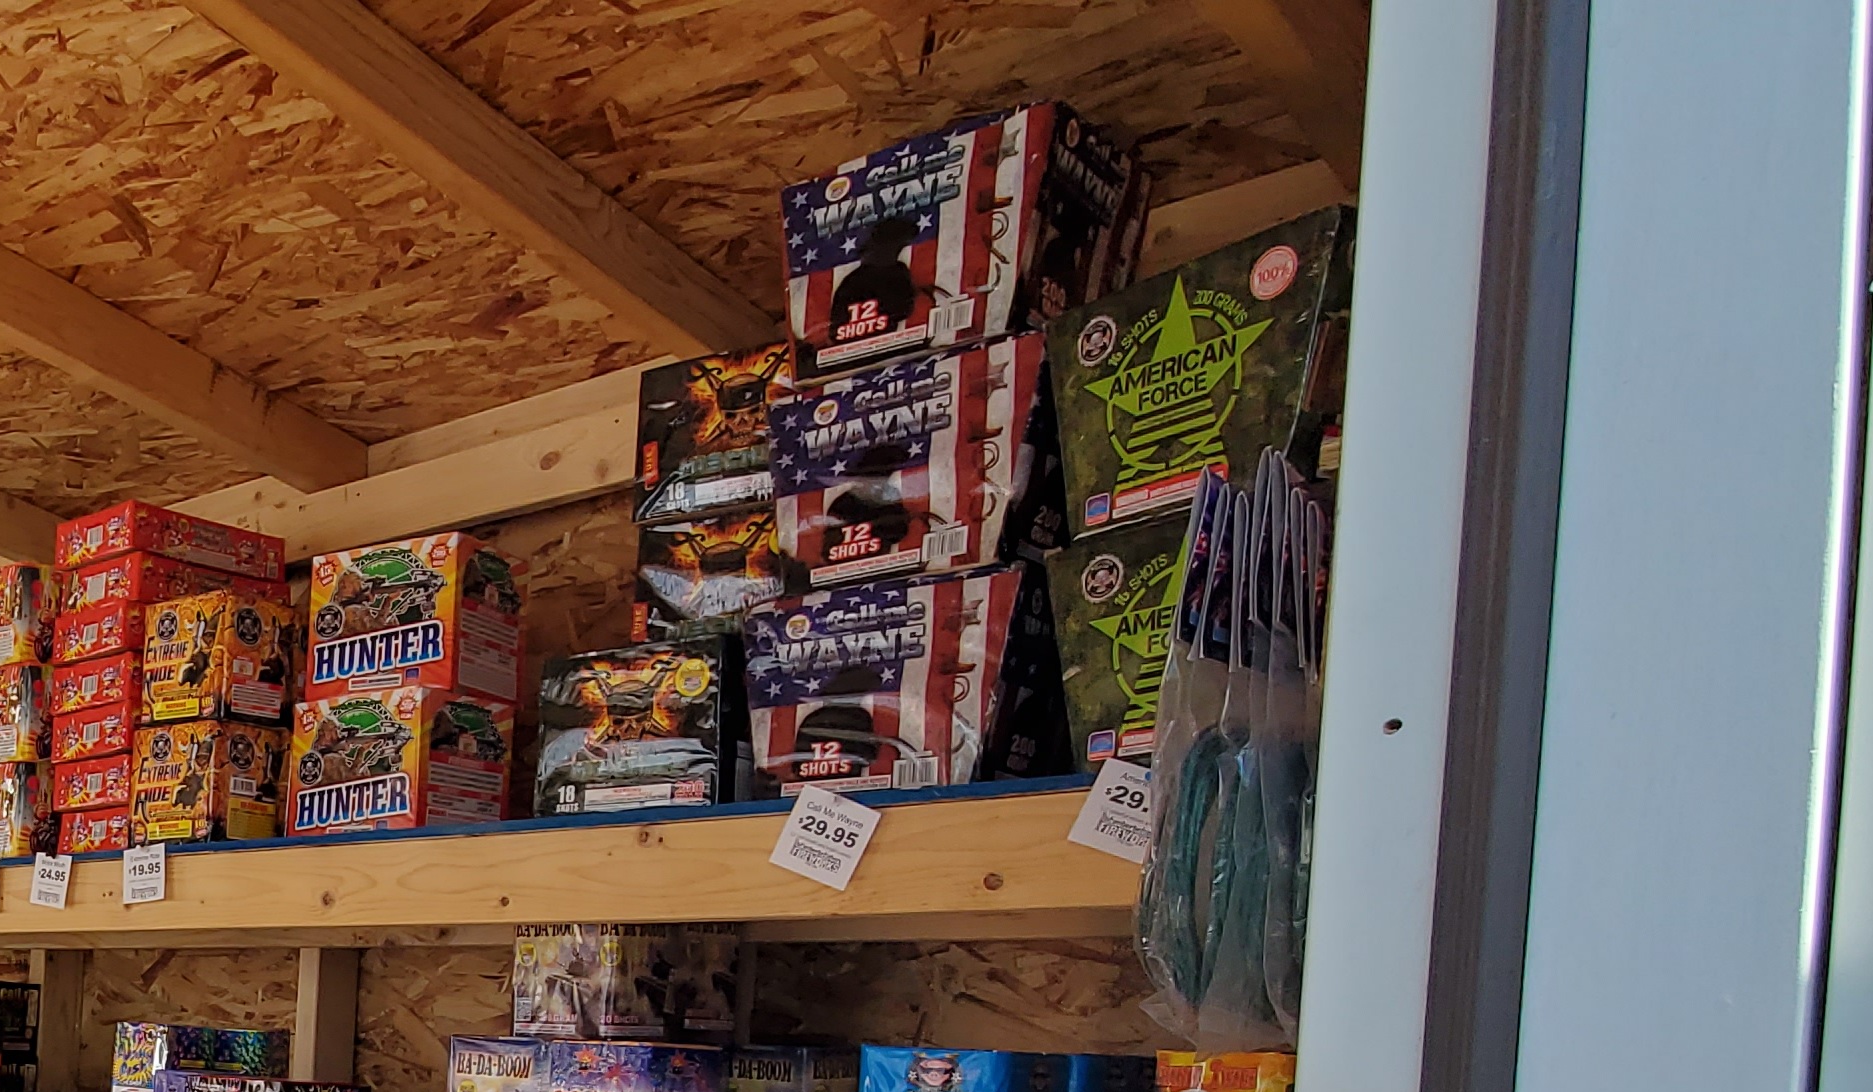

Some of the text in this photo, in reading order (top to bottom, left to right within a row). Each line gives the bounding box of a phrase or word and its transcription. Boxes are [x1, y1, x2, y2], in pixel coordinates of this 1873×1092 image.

[814, 165, 964, 239] WAYNE
[847, 300, 878, 321] 12
[836, 316, 889, 341] SHOTS
[1121, 310, 1158, 350] SHOTS
[1108, 334, 1237, 400] AMERICAN
[1138, 371, 1208, 411] FORCE
[804, 394, 952, 460] WAYNE
[829, 537, 881, 562] SHOTS
[841, 523, 872, 544] 12
[312, 620, 443, 685] HUNTER
[778, 624, 926, 672] WAYNE
[799, 759, 852, 777] SHOTS
[810, 742, 841, 761] 12
[295, 772, 410, 832] HUNTER
[556, 784, 576, 805] 18
[798, 814, 859, 849] $29.95
[456, 1051, 533, 1079] BA-DA-BOOM
